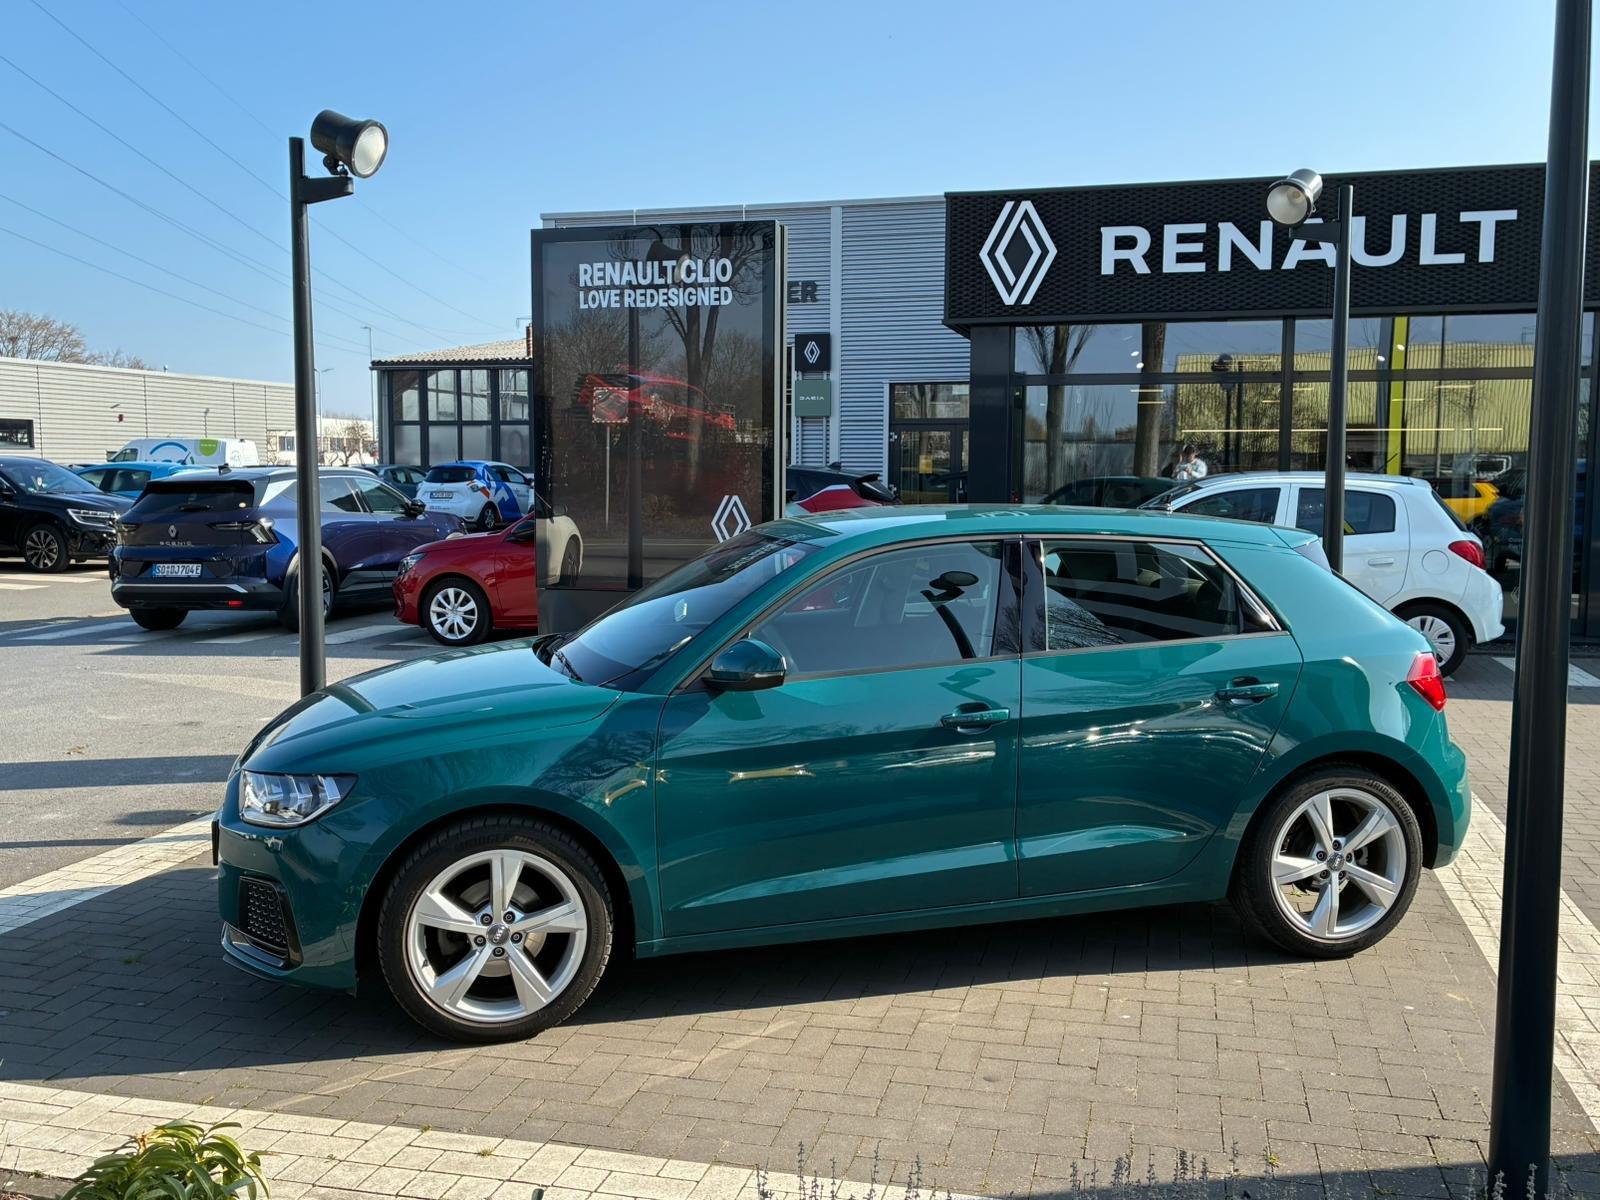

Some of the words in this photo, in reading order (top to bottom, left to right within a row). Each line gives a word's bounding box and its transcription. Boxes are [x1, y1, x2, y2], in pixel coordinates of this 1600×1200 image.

[1101, 209, 1518, 275] RENAULT
[579, 260, 677, 287] RENAULT
[680, 257, 733, 284] CLIO
[579, 289, 621, 309] LOVE
[624, 286, 733, 308] REDESIGNED
